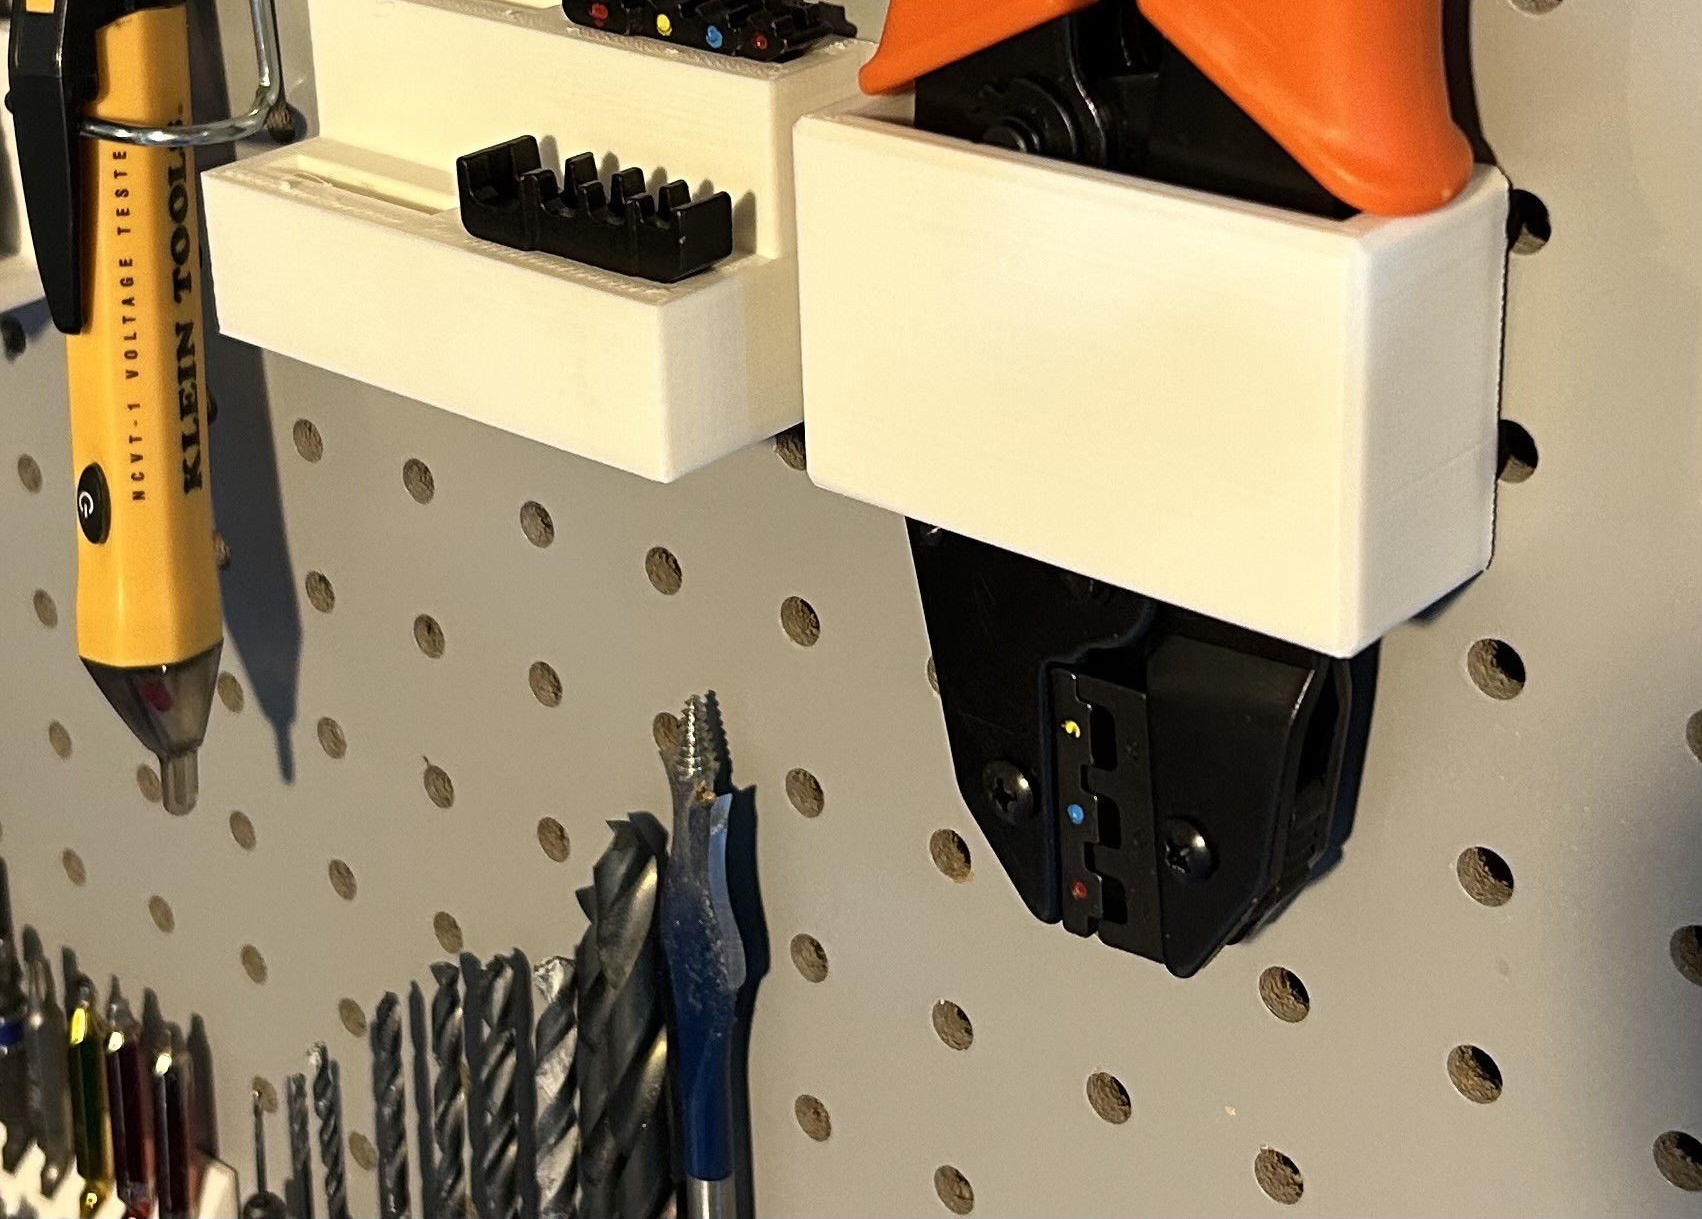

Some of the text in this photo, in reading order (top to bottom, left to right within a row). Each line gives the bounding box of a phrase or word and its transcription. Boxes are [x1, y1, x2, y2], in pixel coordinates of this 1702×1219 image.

[112, 150, 146, 501] NCVT-1 VOLTAGE TESTE
[175, 321, 203, 495] KLEIN
